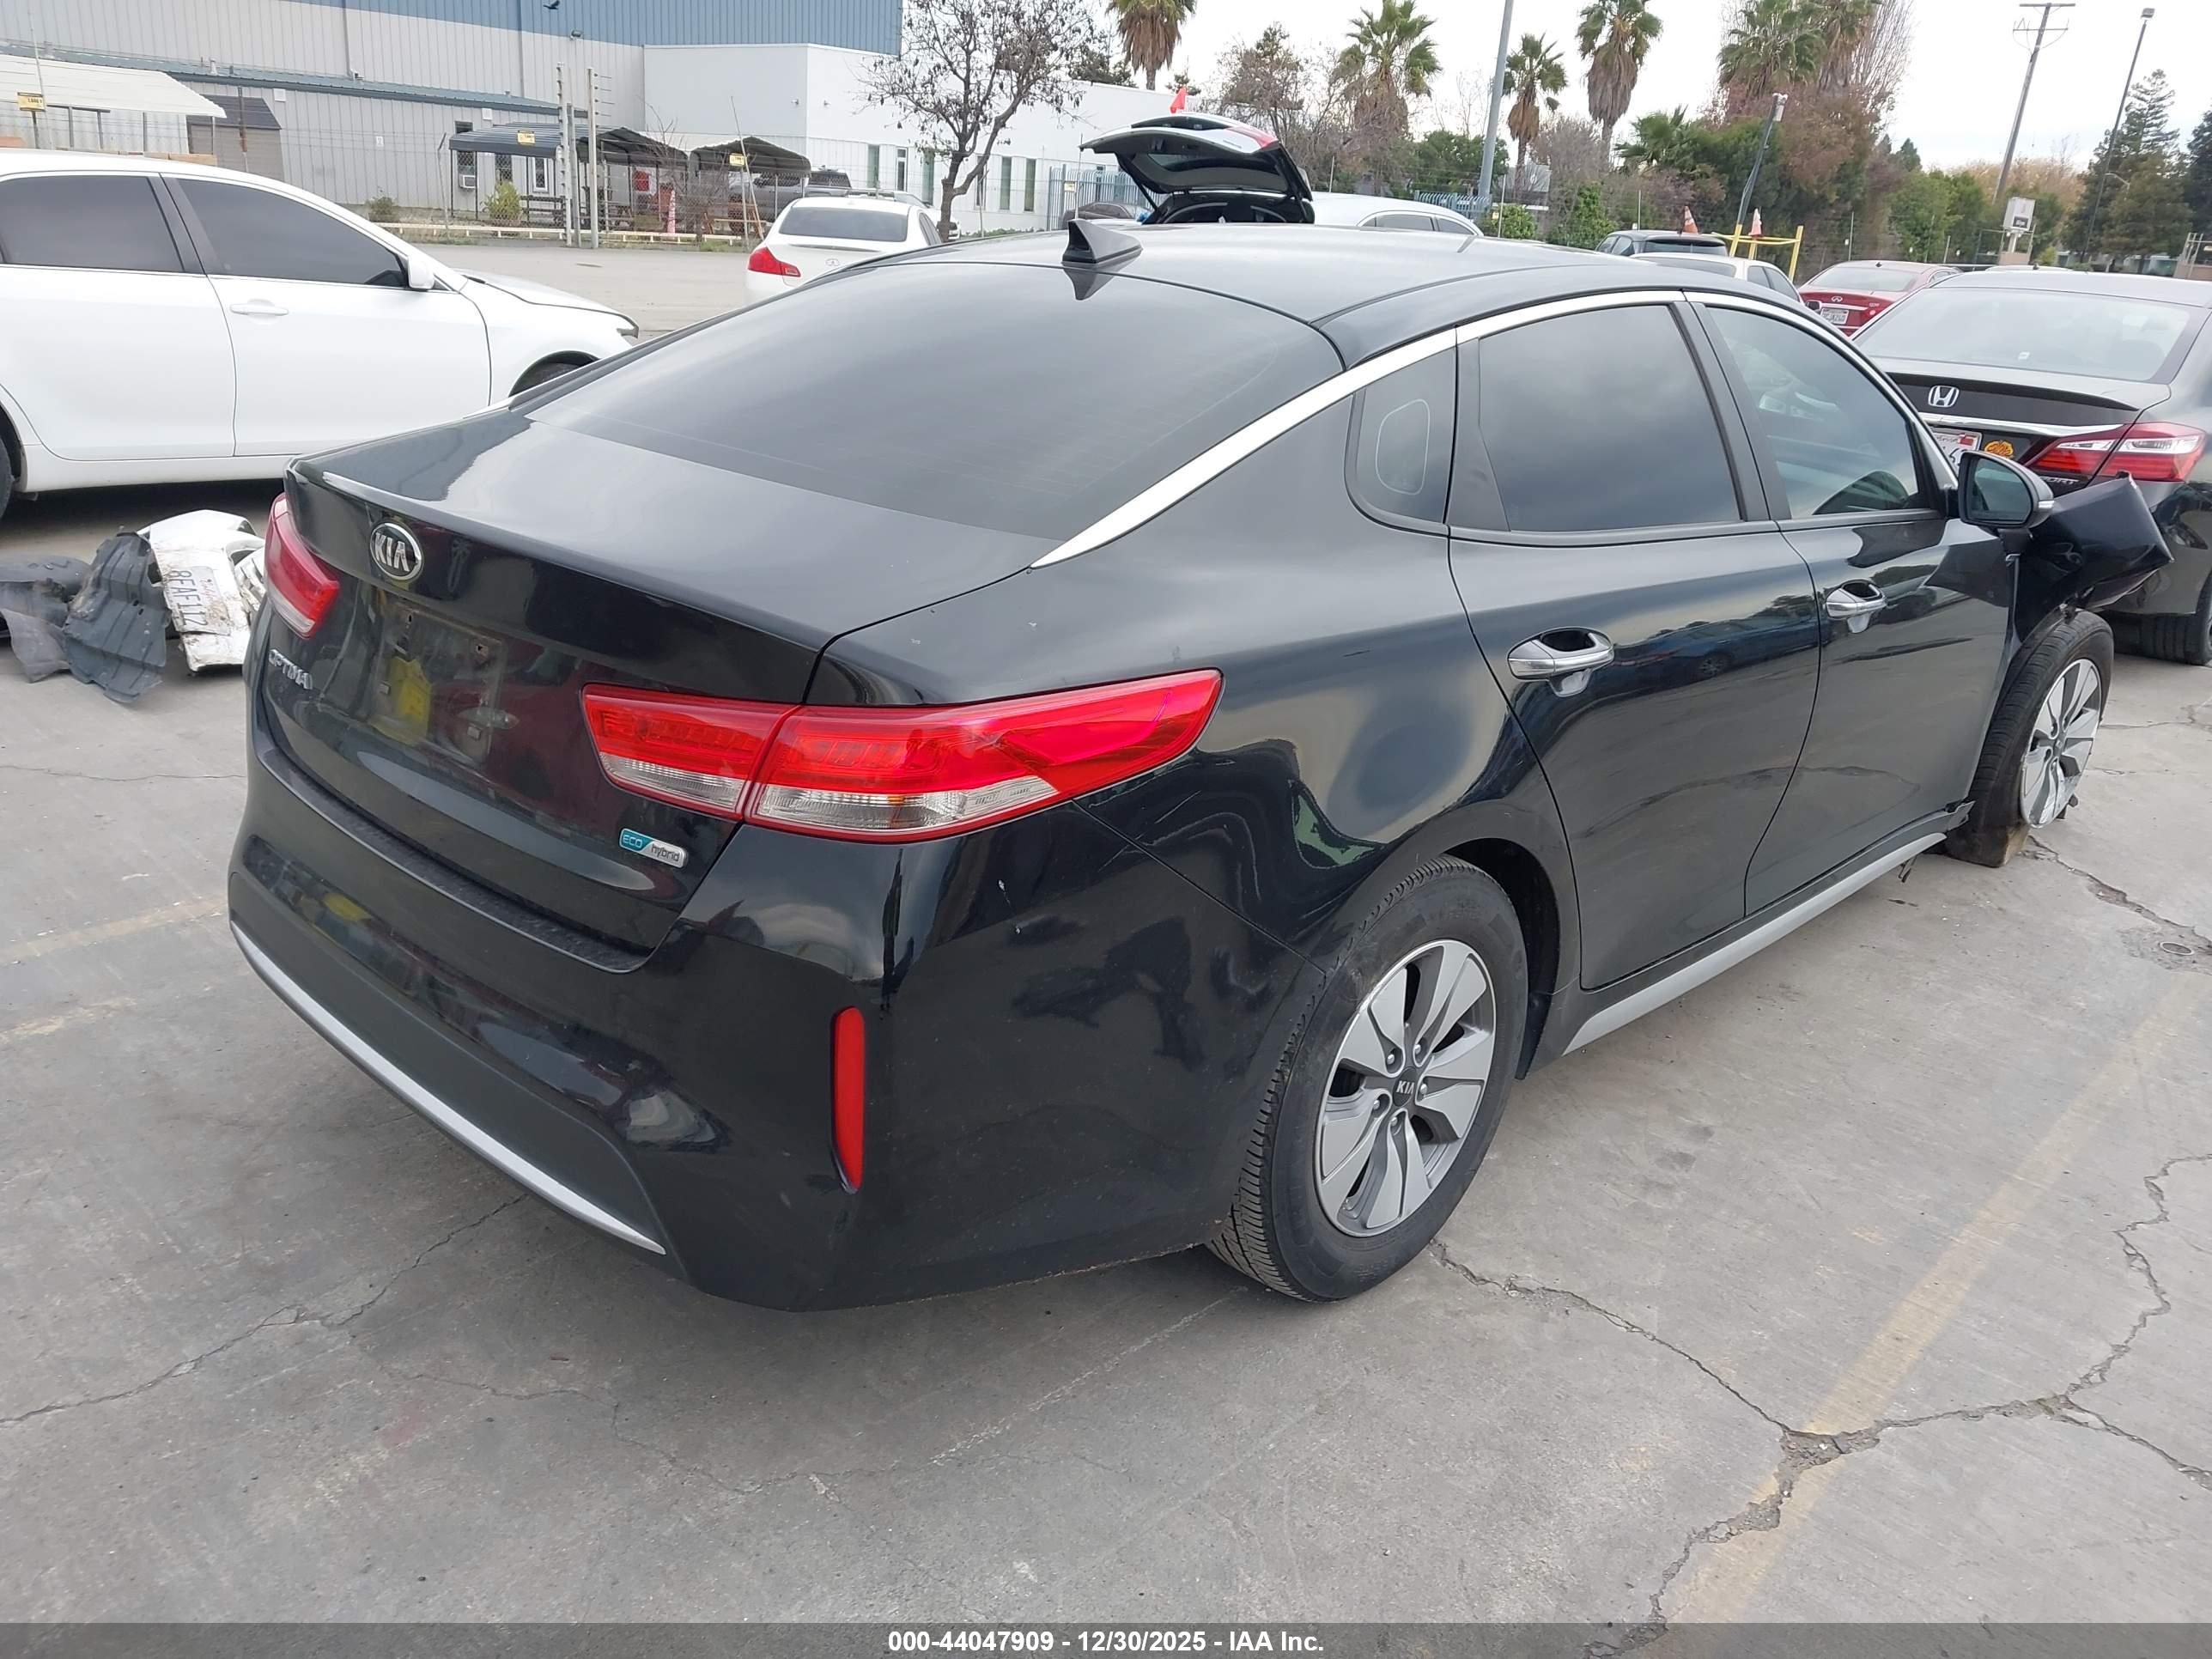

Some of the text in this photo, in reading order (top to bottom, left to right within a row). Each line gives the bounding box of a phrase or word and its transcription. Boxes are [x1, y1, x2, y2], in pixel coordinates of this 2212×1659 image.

[375, 532, 410, 572] KIA
[623, 834, 681, 862] ECO hybrid
[1395, 1080, 1415, 1095] KIA
